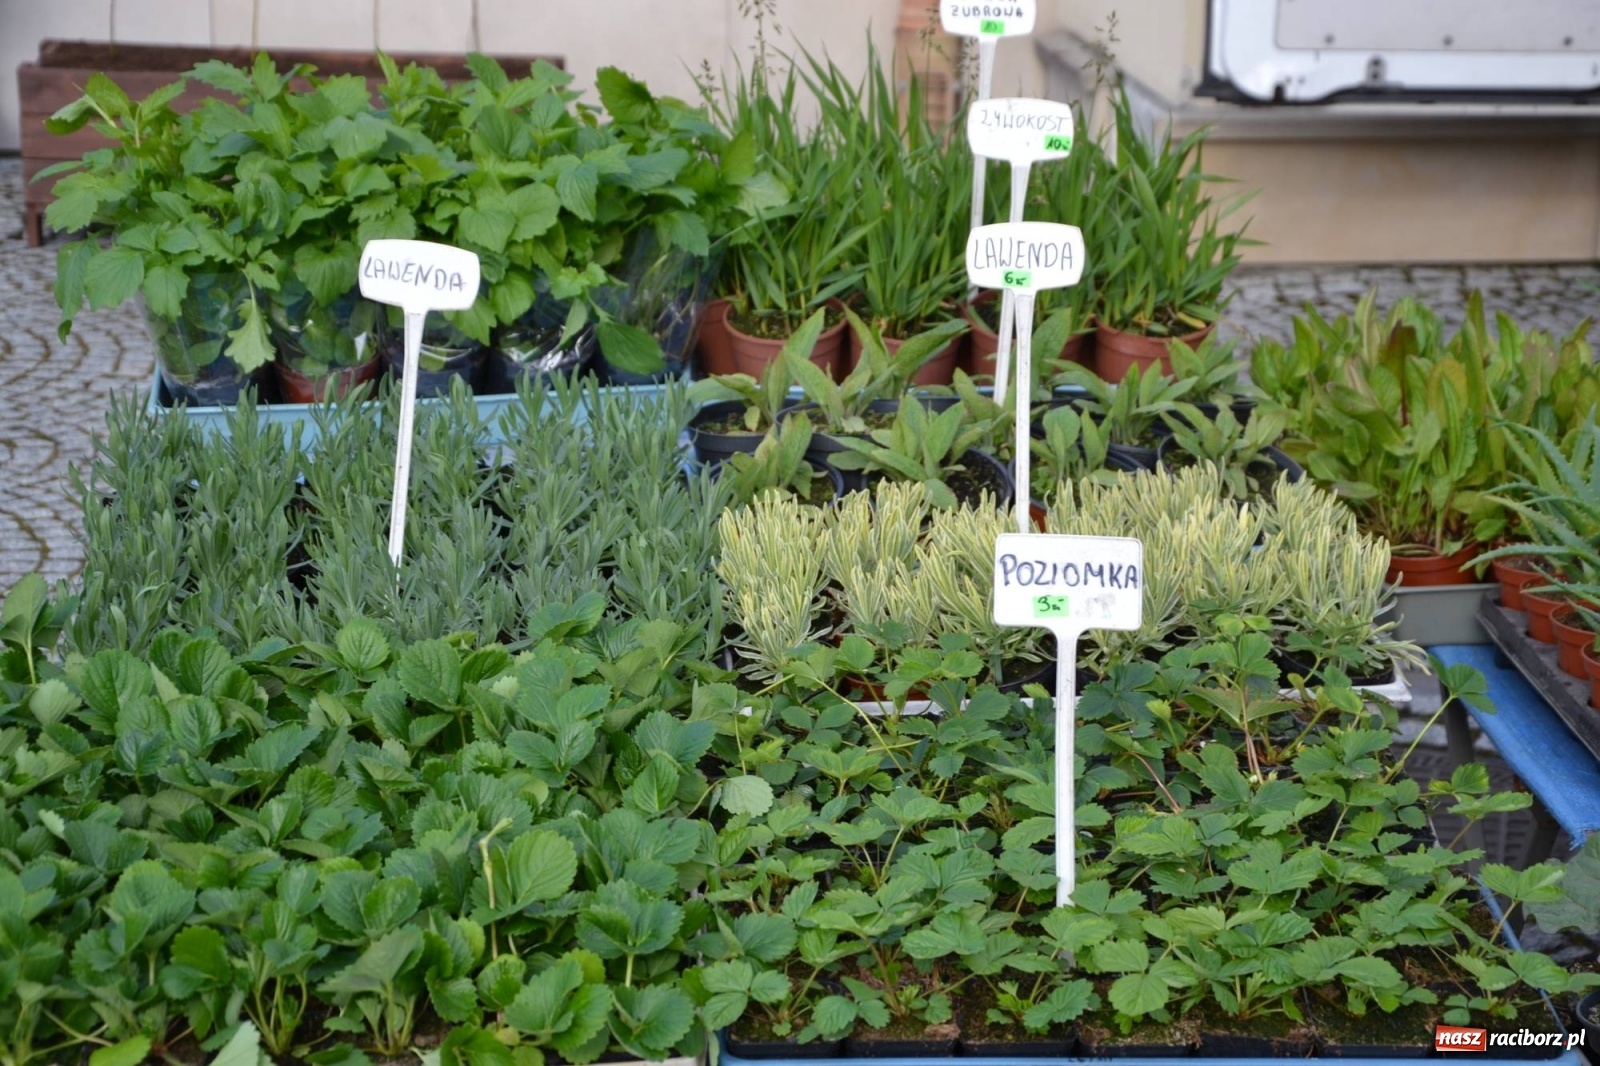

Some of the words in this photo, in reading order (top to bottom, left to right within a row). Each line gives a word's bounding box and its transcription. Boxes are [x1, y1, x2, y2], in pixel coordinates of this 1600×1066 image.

[974, 237, 1073, 271] LAWENDA
[363, 256, 467, 293] LAWENDA
[999, 553, 1139, 589] POZIOMKA
